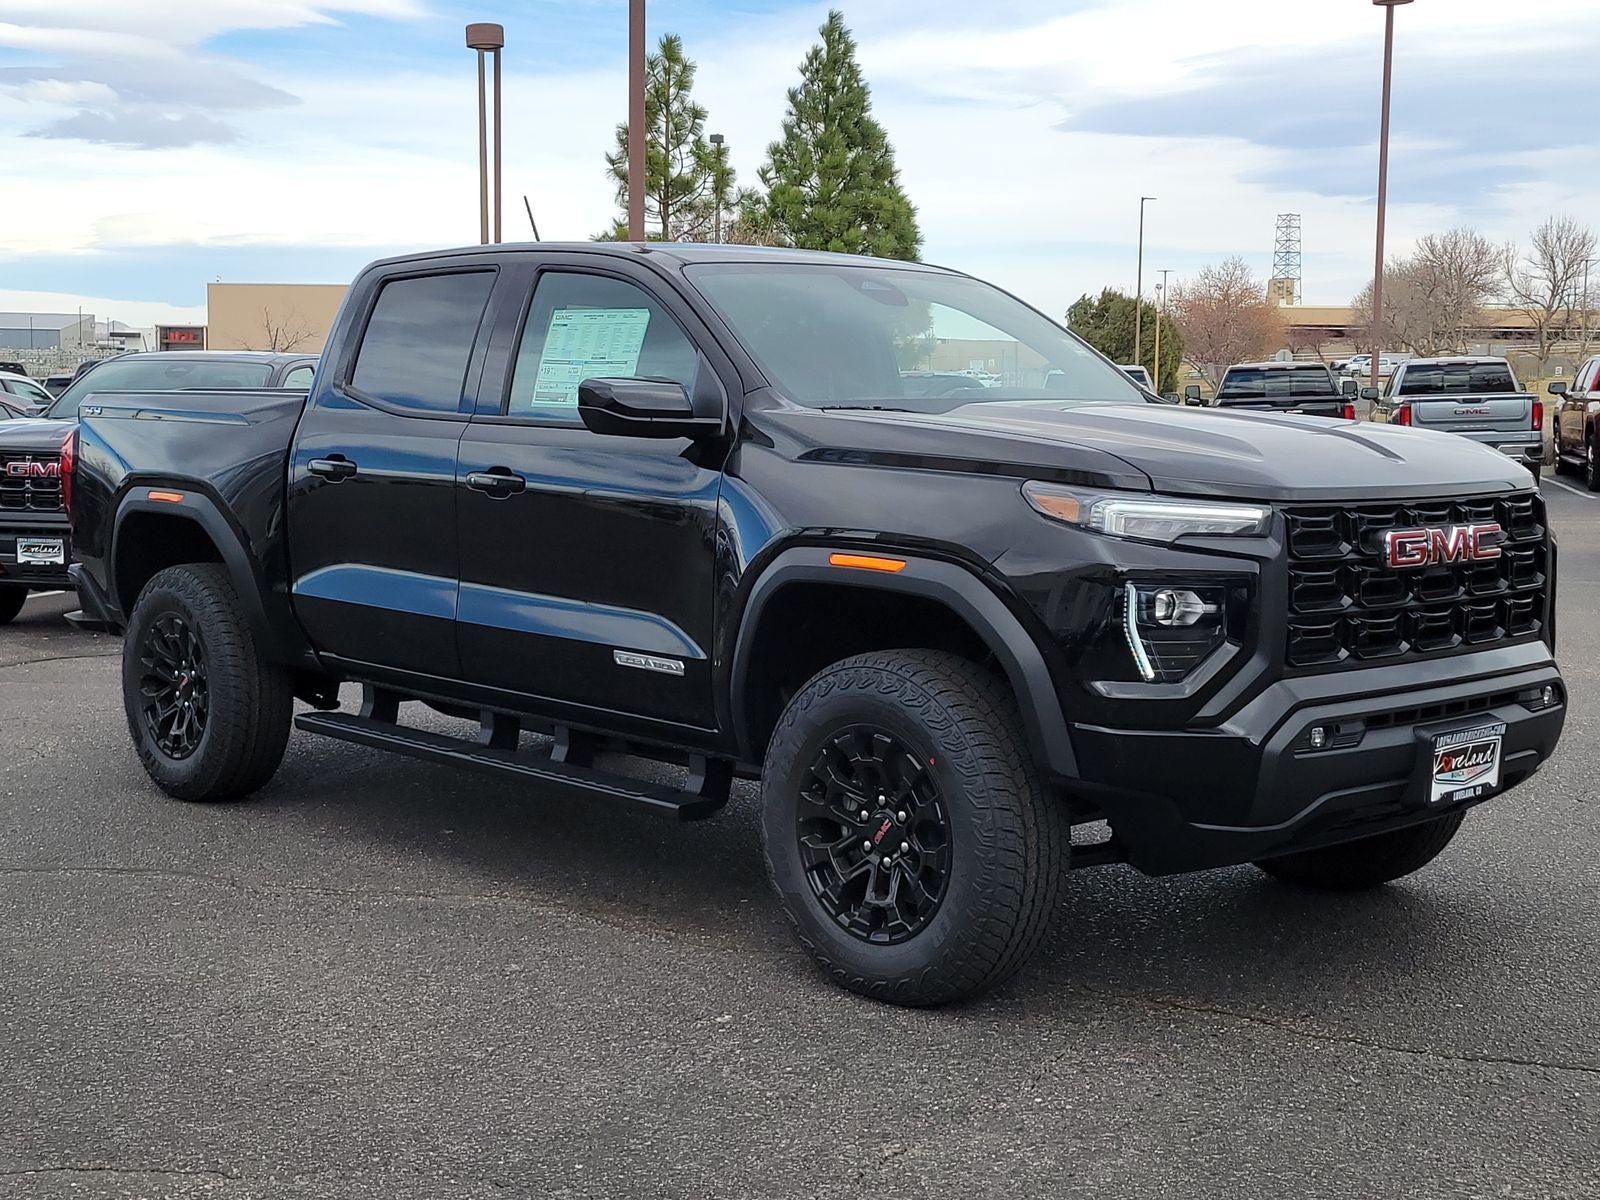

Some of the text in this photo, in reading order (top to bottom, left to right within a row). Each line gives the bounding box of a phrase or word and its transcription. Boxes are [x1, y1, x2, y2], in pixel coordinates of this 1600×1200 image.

[1454, 407, 1490, 415] GMC
[6, 461, 62, 477] GM
[1386, 523, 1502, 568] GMC
